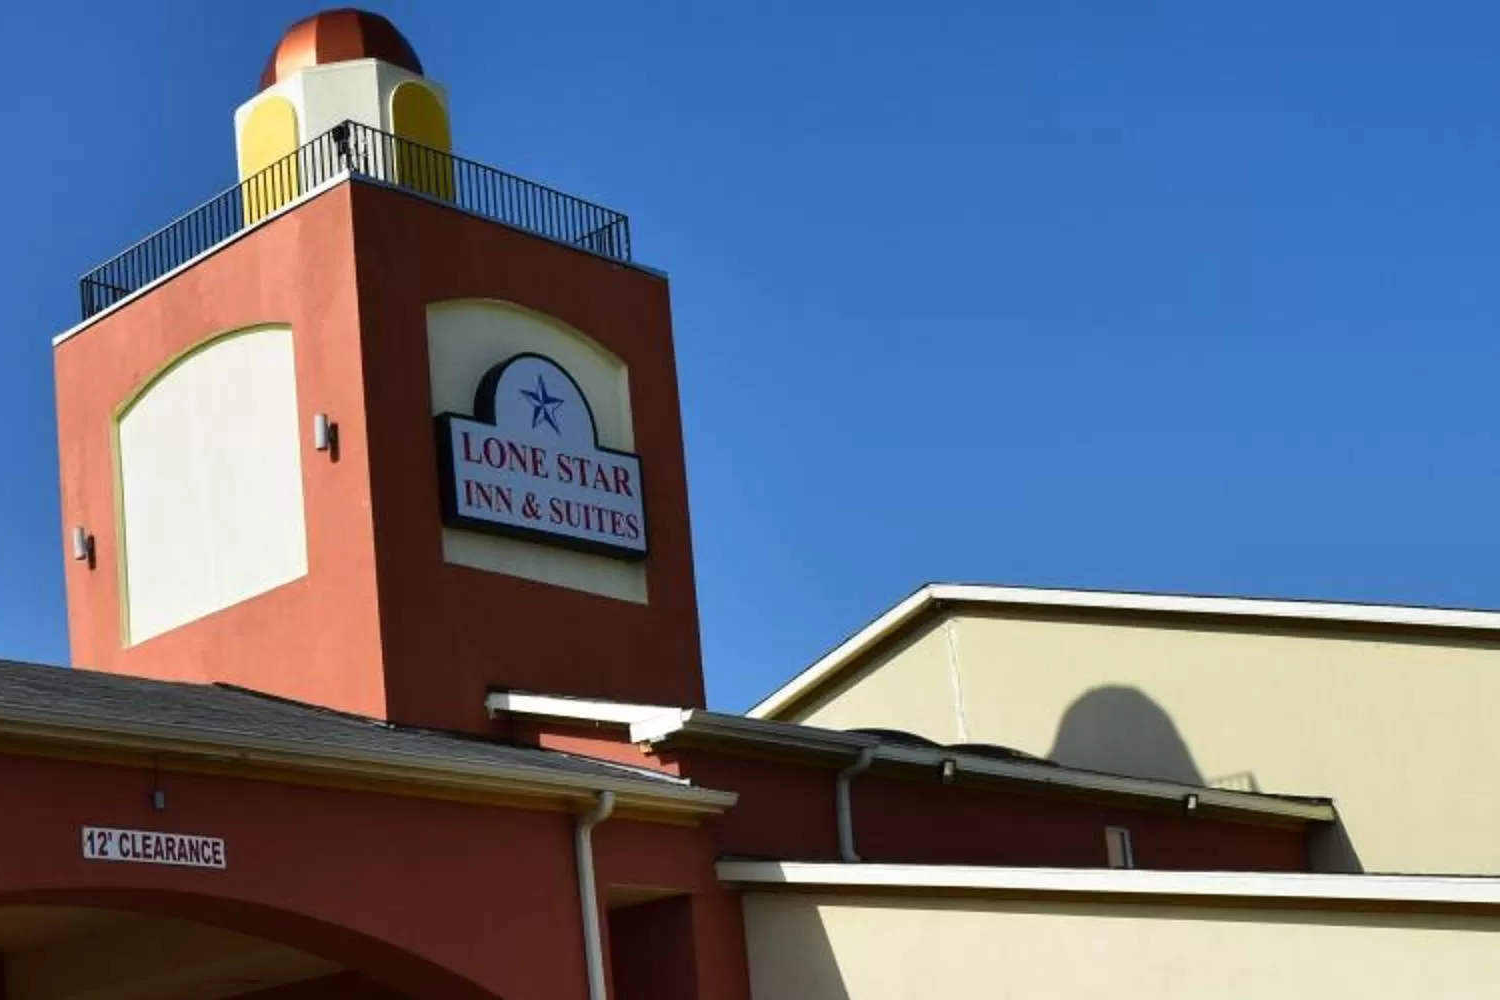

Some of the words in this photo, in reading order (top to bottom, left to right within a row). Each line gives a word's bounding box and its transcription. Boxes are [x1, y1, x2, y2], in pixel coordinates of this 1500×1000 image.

[461, 431, 549, 479] LONE
[557, 453, 633, 498] STAR
[463, 479, 513, 514] INN
[521, 491, 543, 521] &
[549, 497, 640, 541] SUITES
[119, 833, 223, 865] CLEARANCE
